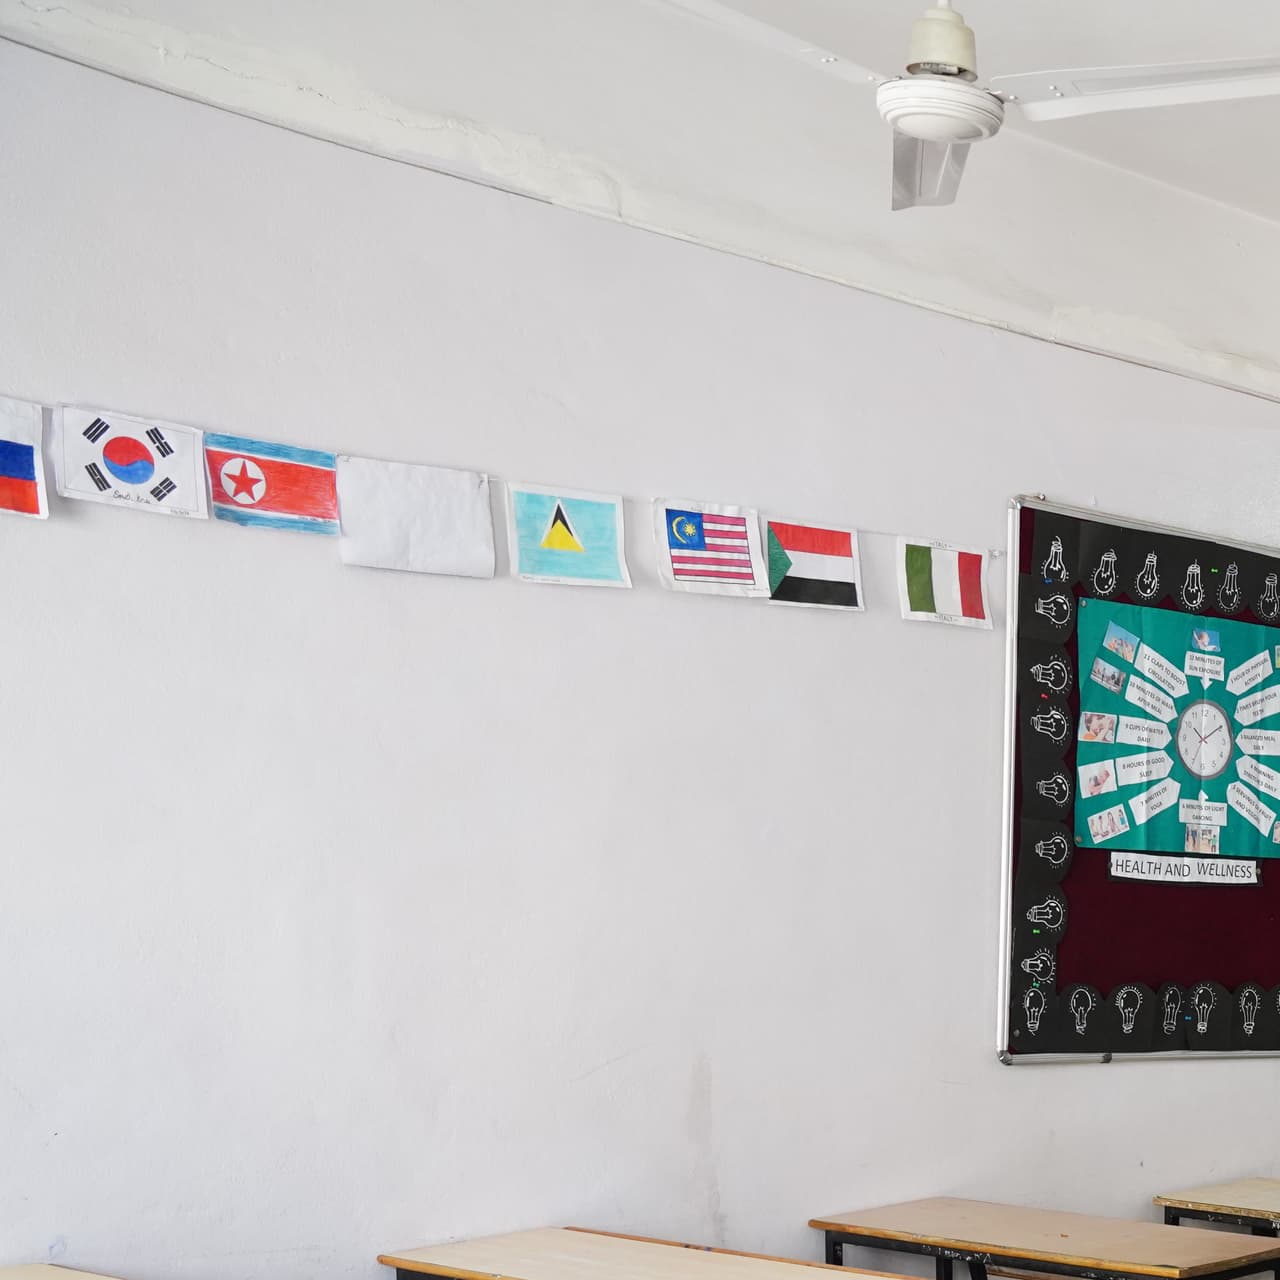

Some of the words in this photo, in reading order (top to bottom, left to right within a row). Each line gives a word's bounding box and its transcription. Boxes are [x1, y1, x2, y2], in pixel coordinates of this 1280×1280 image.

[1201, 709, 1208, 718] 12
[1115, 858, 1162, 876] HEALTH
[1165, 862, 1191, 877] AND
[1196, 862, 1252, 878] WELLNESS
